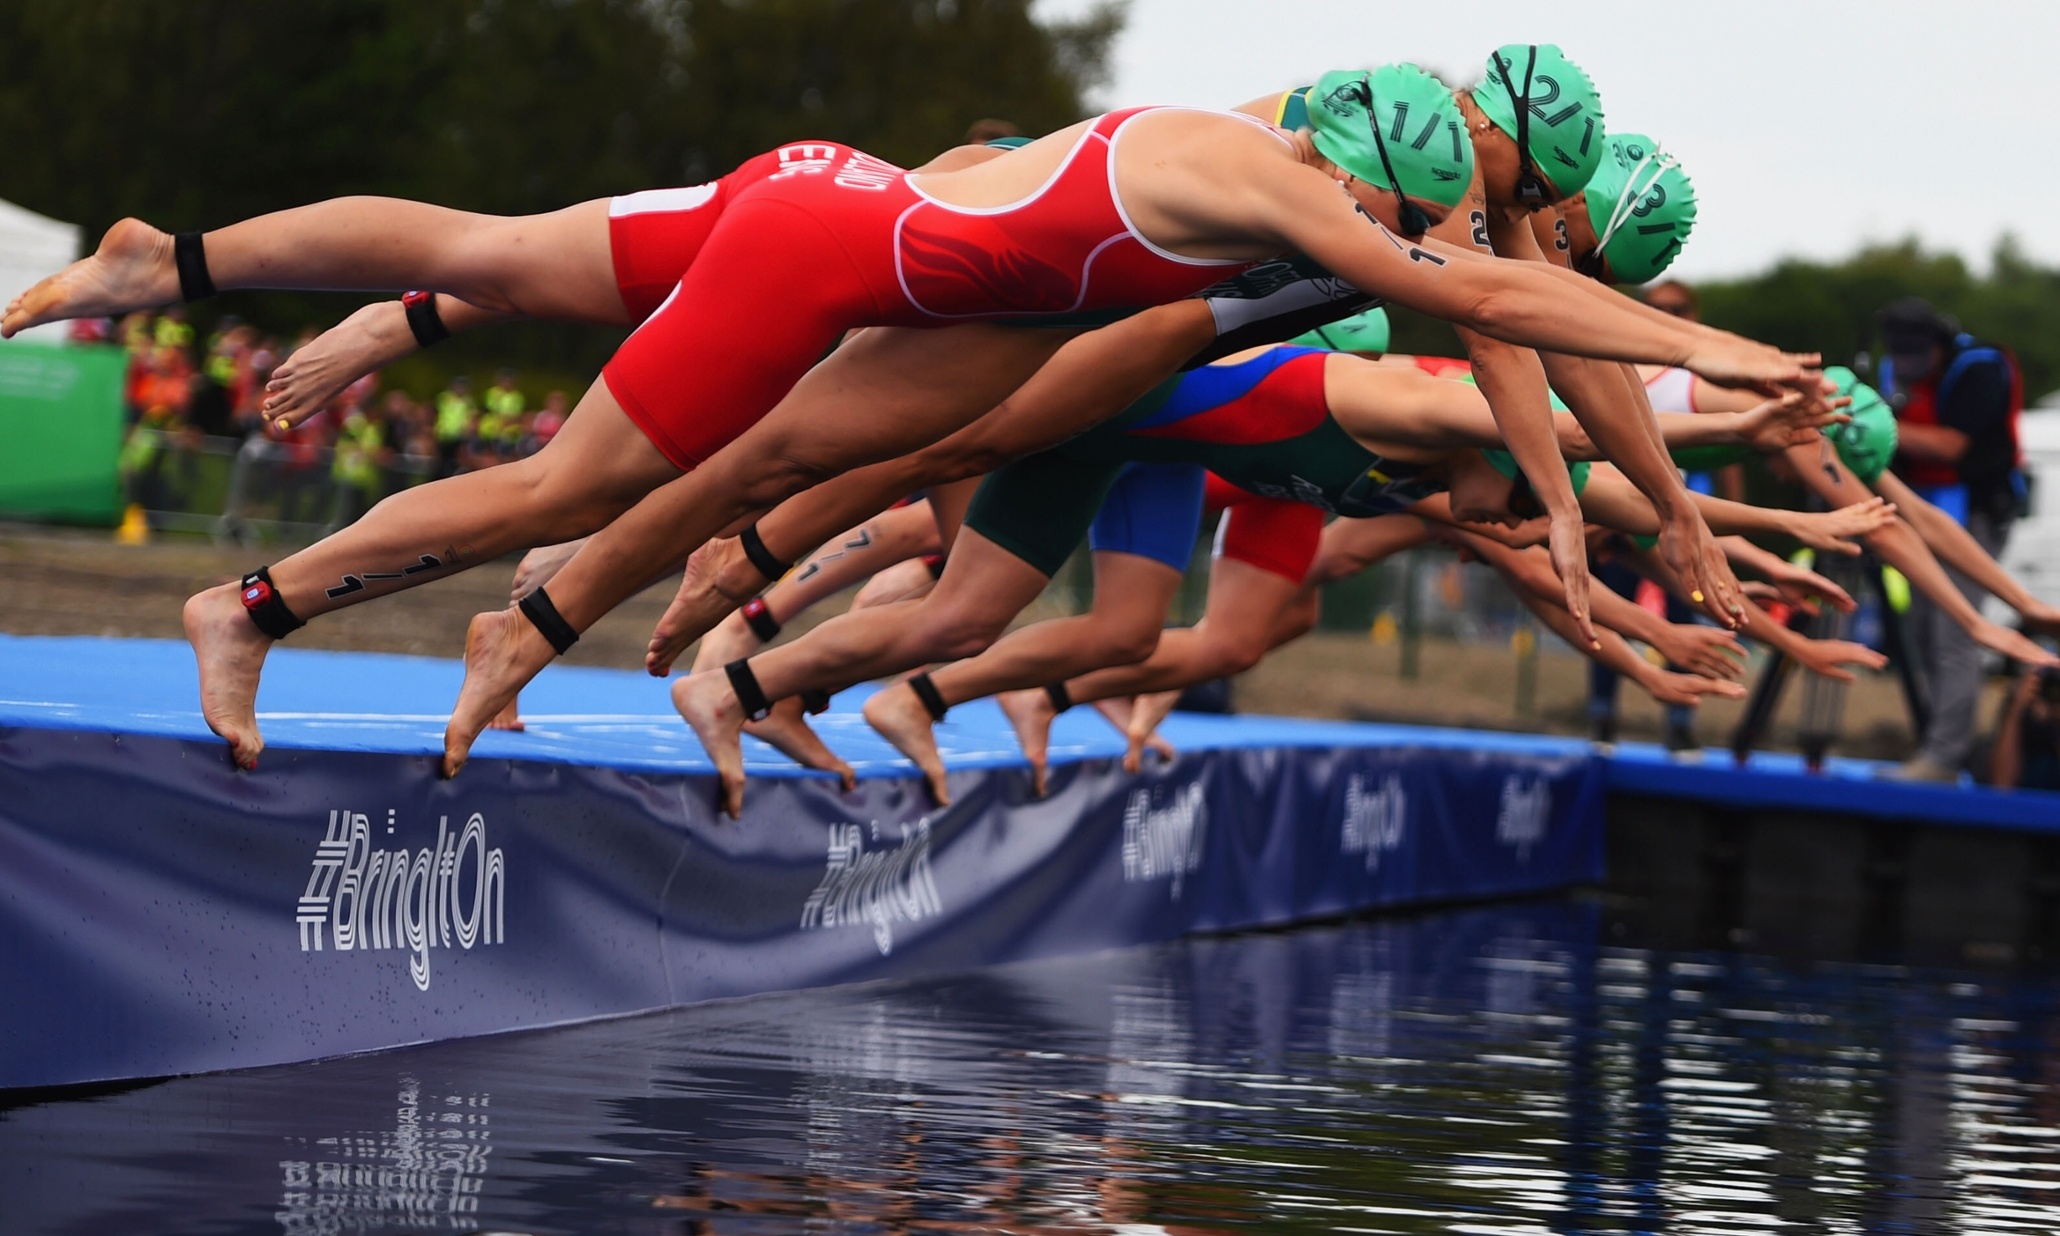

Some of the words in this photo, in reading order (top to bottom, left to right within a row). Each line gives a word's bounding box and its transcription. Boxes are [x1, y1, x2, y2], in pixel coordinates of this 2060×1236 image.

[1389, 100, 1464, 163] 1/1
[1526, 74, 1595, 158] 2/1
[1354, 202, 1449, 268] 1/1
[1469, 208, 1496, 258] 2
[1626, 182, 1682, 268] 3/1
[324, 552, 444, 600] 1/1
[295, 808, 506, 992] #BringItOn
